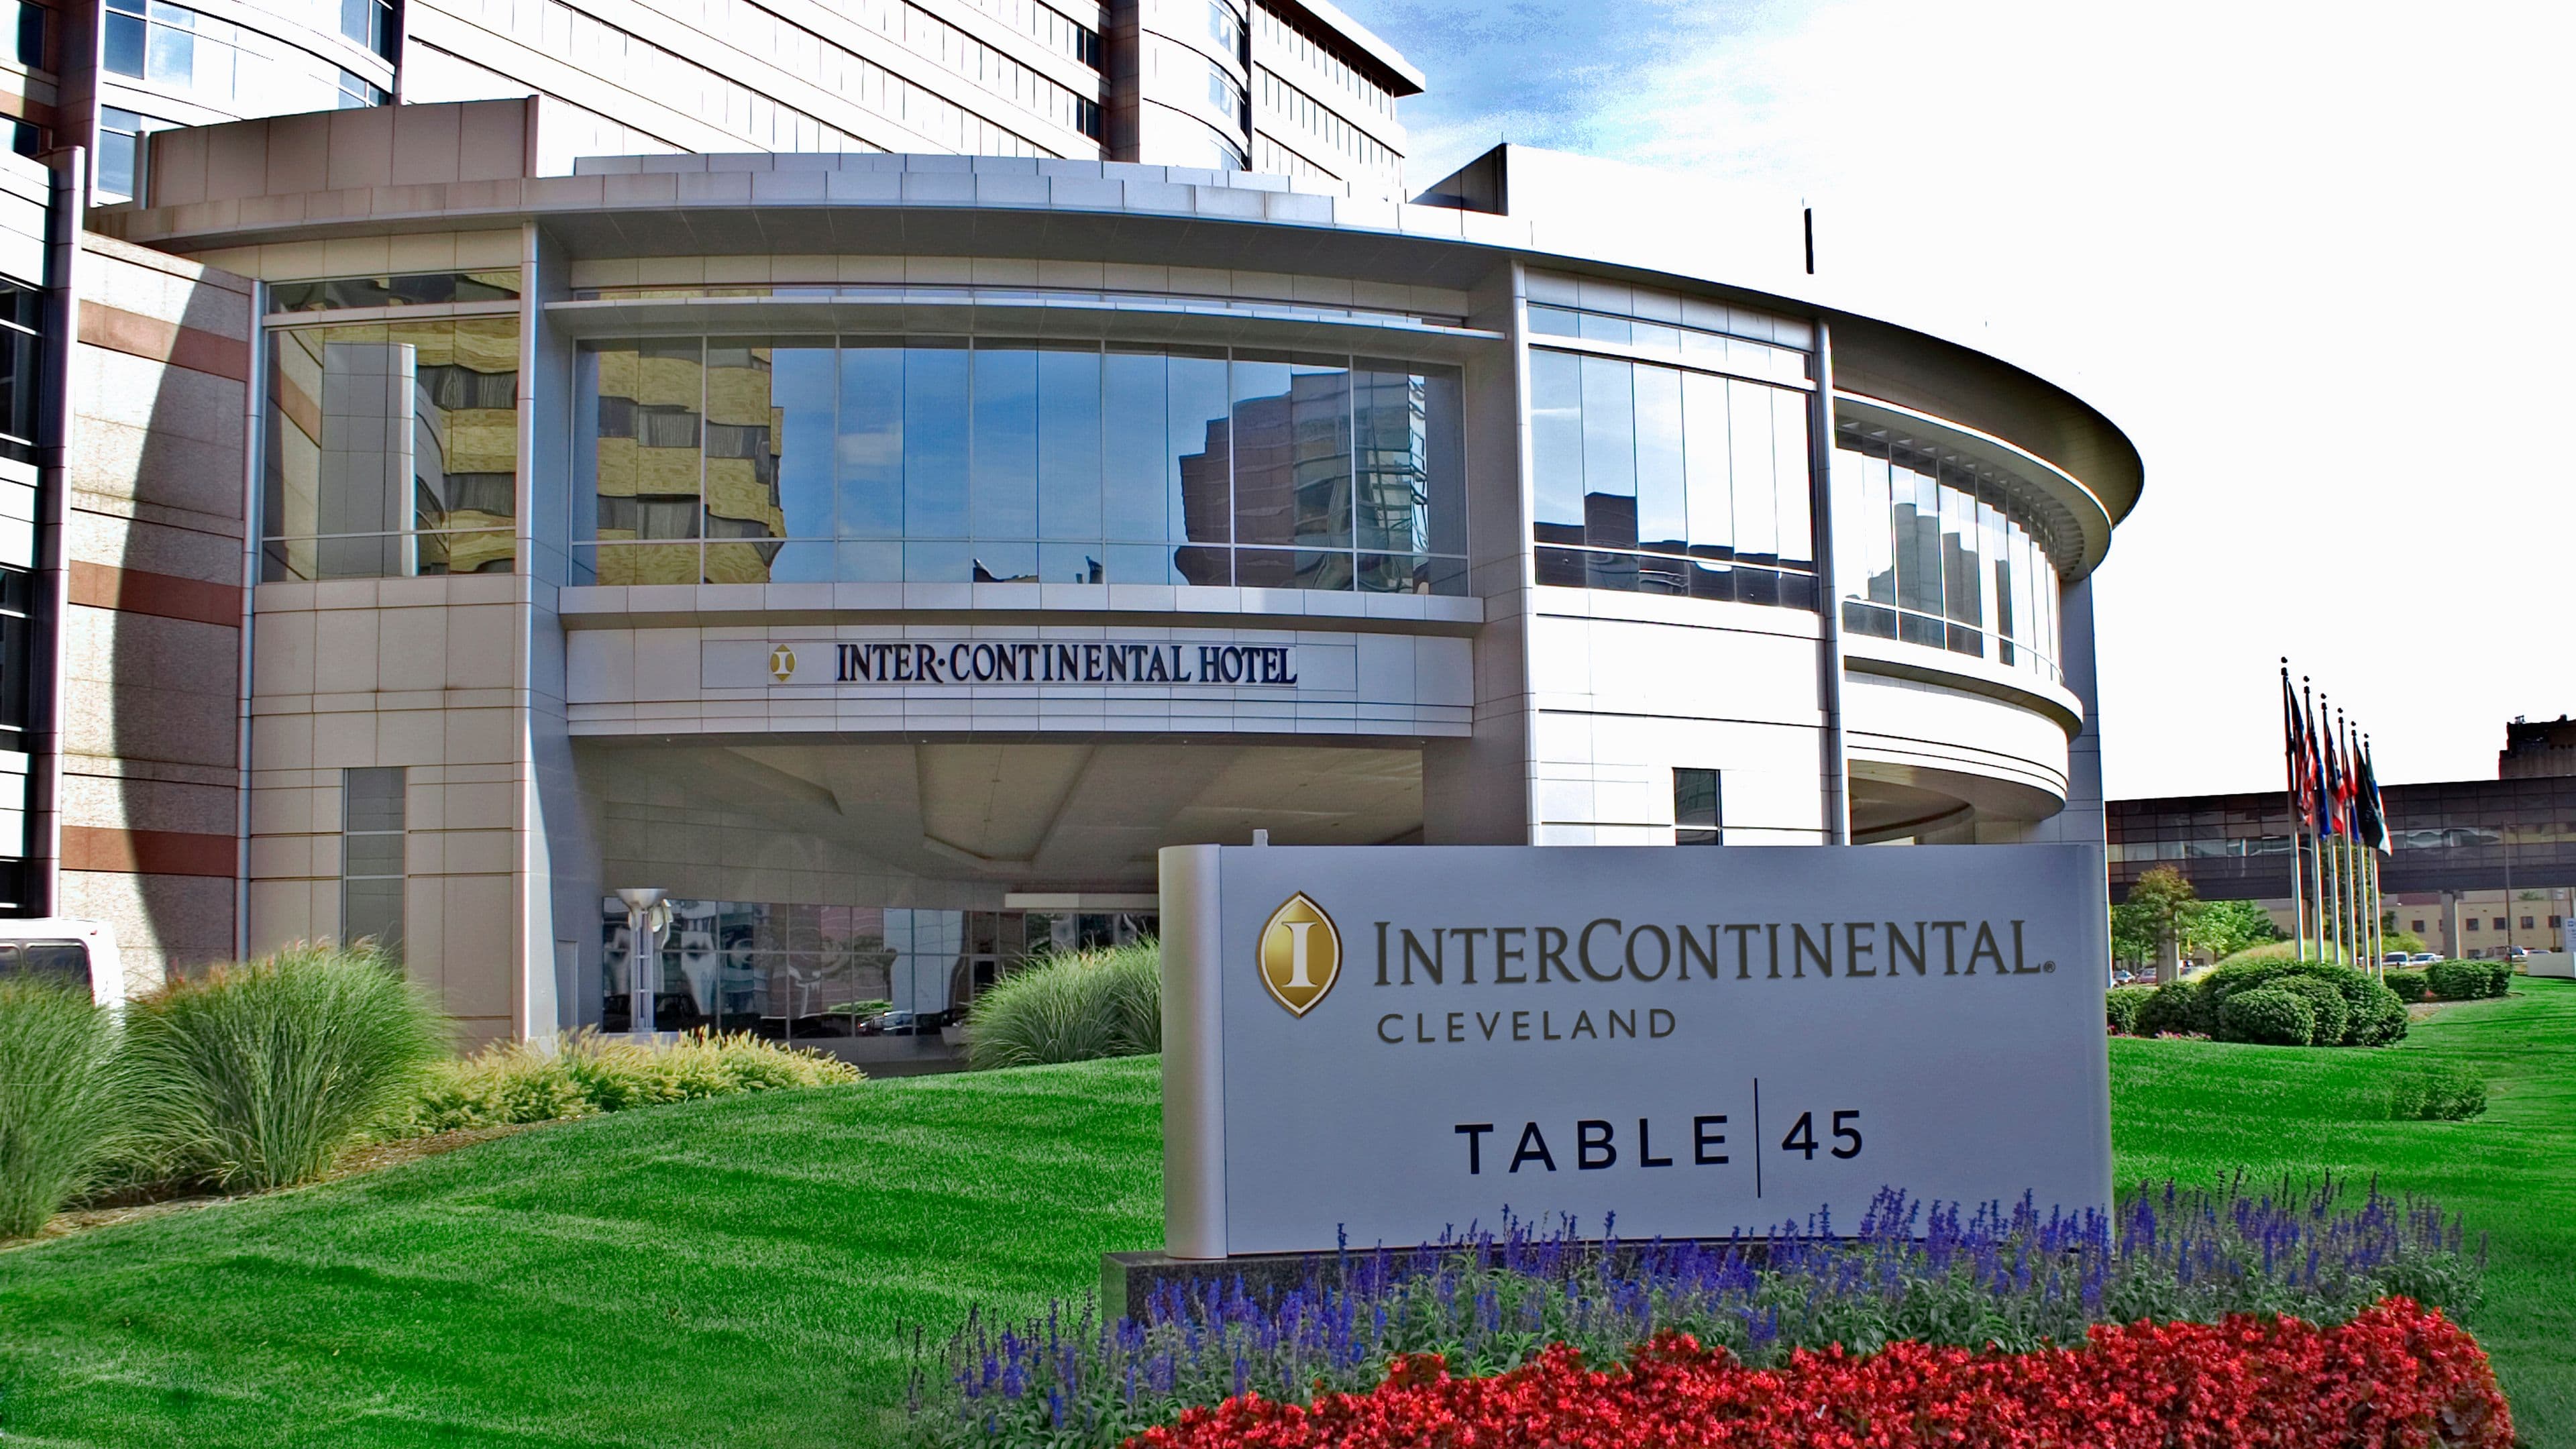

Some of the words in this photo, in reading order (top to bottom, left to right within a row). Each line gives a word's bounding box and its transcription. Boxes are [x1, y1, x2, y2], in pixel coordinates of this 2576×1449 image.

[1198, 646, 1298, 684] HOTEL
[1377, 1008, 1676, 1044] CLEVELAND
[1454, 1115, 1729, 1175] TABLE
[1781, 1110, 1863, 1161] 45
